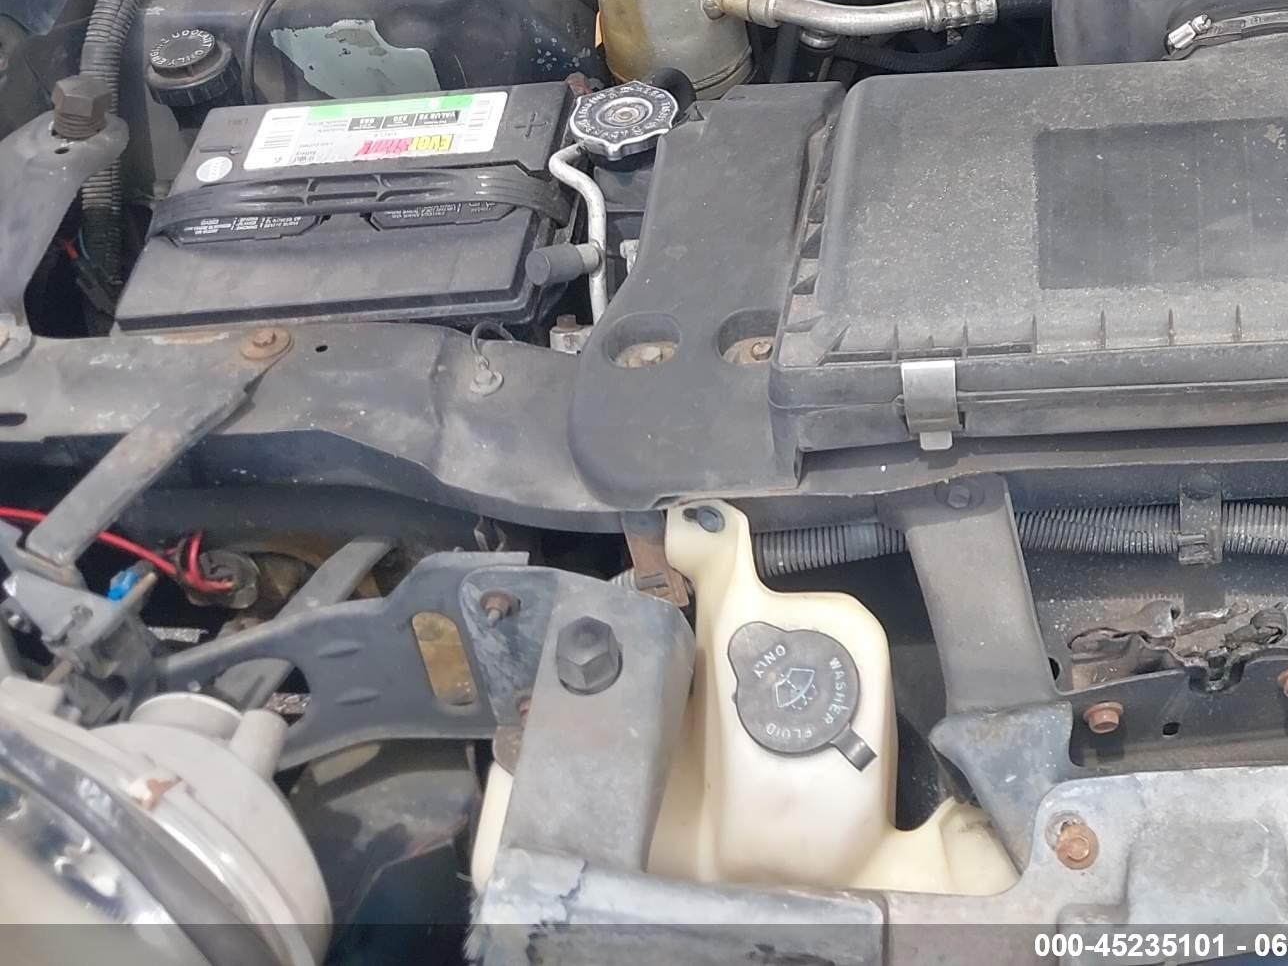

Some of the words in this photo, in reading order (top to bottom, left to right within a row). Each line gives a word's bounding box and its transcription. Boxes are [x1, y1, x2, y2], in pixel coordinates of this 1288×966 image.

[753, 644, 786, 679] ONLY
[823, 657, 847, 724] WASHER
[766, 722, 813, 739] FLUID
